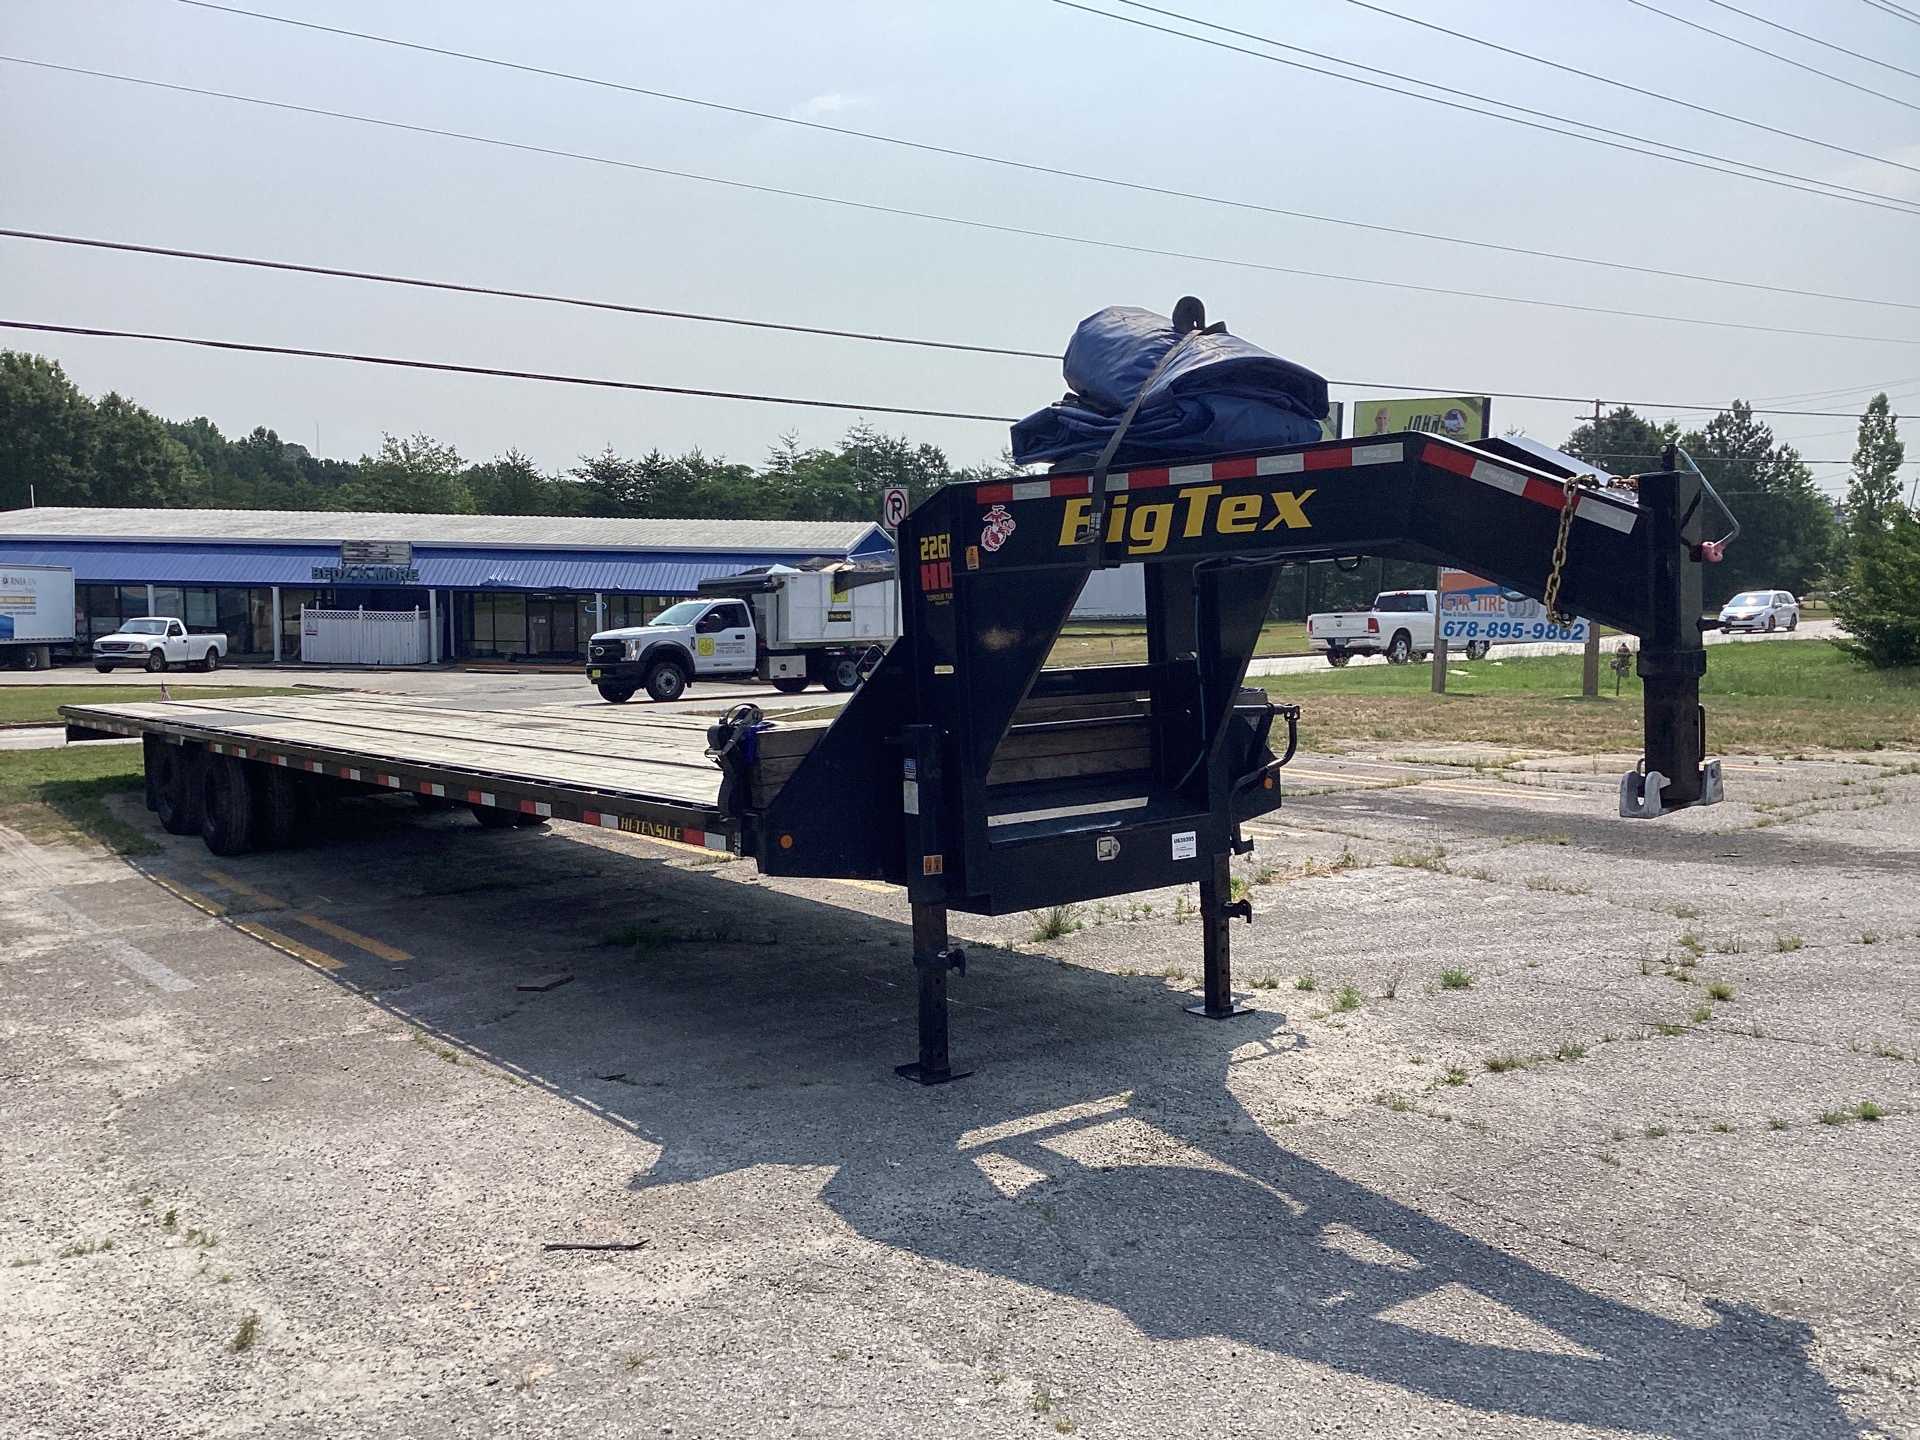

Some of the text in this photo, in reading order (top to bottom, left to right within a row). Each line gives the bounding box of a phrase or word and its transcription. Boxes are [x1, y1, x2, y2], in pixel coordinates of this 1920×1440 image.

[1058, 486, 1317, 555] BigTex
[1443, 594, 1505, 612] GTR TIRE
[620, 817, 682, 841] HI-TENSILE
